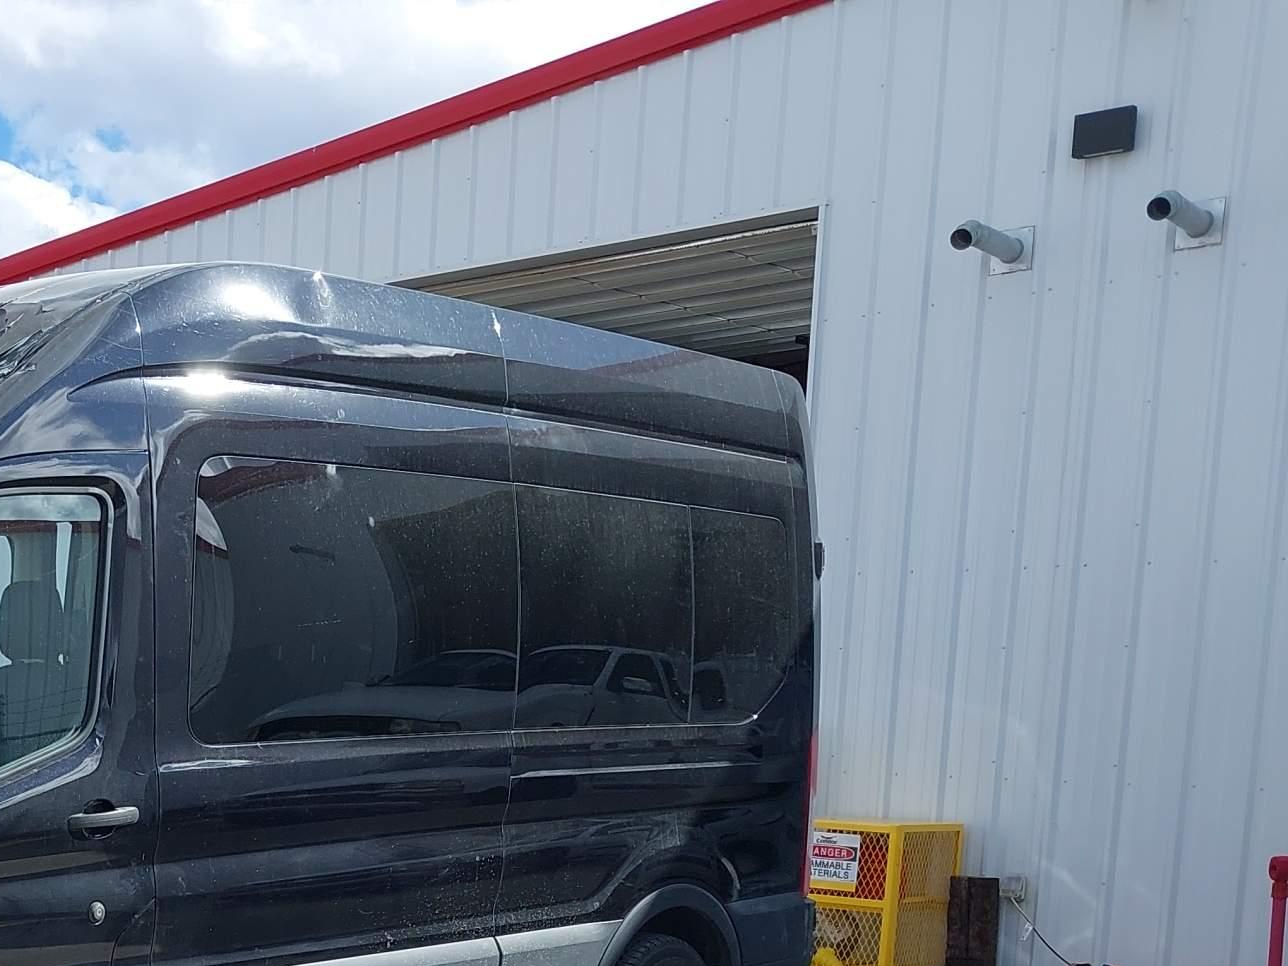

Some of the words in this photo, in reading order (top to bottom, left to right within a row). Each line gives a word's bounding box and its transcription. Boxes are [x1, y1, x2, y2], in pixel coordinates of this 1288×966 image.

[813, 846, 848, 858] ANGER
[811, 859, 852, 871] AMMABLE
[811, 868, 850, 880] TERIALS
